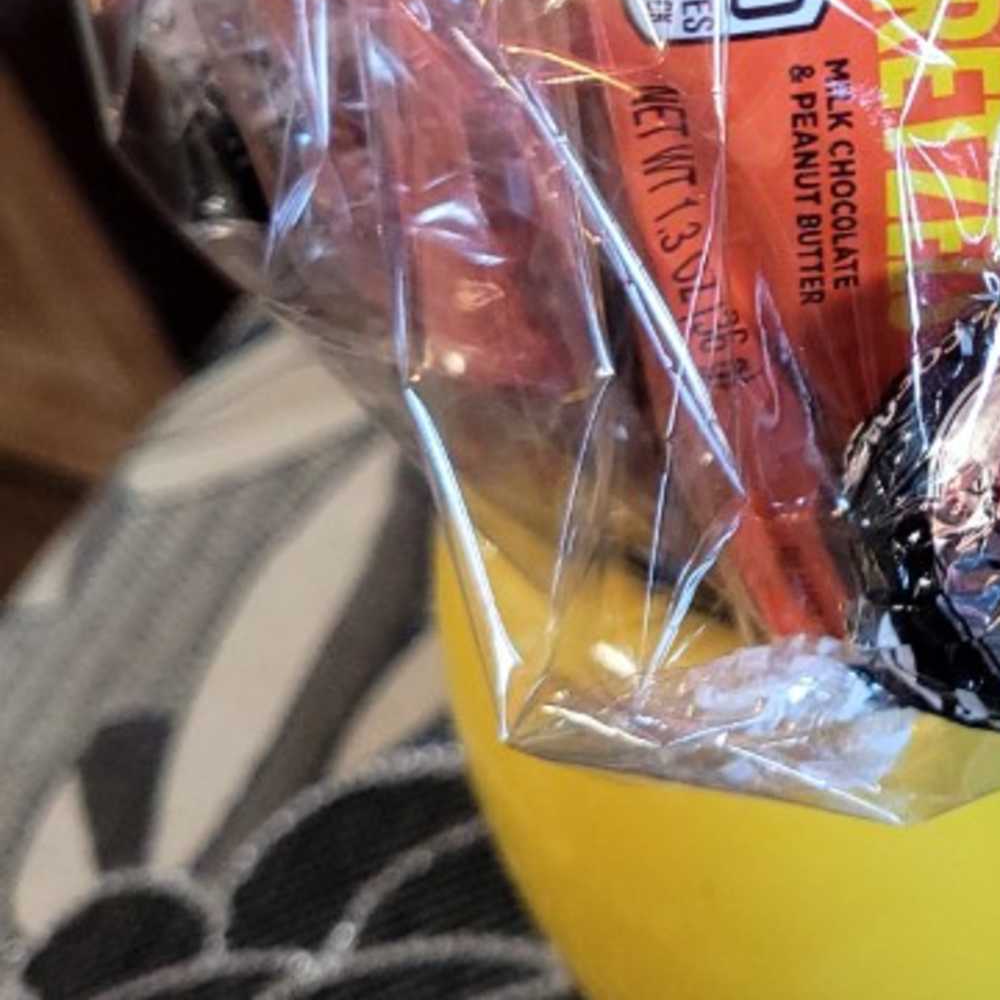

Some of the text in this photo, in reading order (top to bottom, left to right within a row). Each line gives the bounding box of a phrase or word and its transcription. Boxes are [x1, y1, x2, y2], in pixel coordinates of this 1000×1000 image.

[631, 85, 689, 139] NET
[642, 144, 697, 193] WT
[788, 65, 827, 307] & PEANUT BUTTER
[824, 58, 860, 291] MILK CHOCOLATE
[655, 196, 702, 252] 1.3
